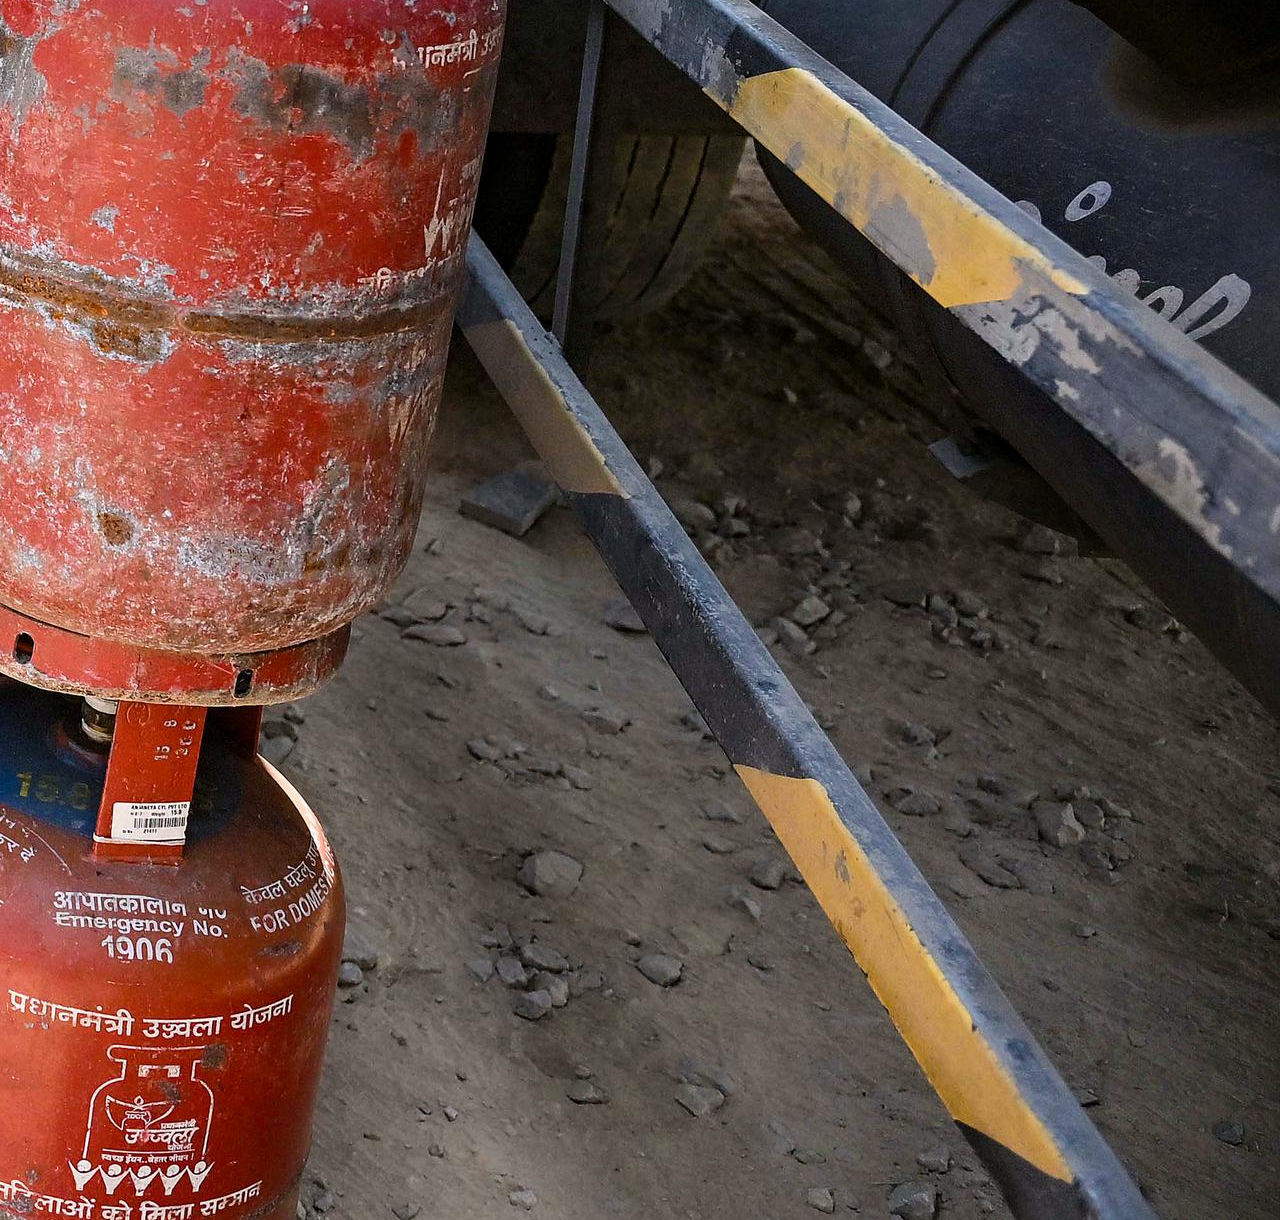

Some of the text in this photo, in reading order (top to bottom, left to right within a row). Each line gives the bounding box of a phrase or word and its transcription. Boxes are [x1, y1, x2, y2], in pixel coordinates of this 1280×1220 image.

[241, 861, 317, 906] केवल घरेलू
[54, 911, 228, 939] Emergency No.
[250, 908, 290, 934] FOR
[102, 935, 174, 965] 1906
[8, 989, 295, 1037] प्रधानमंत्री योजना
[200, 1180, 263, 1218] सम्मान
